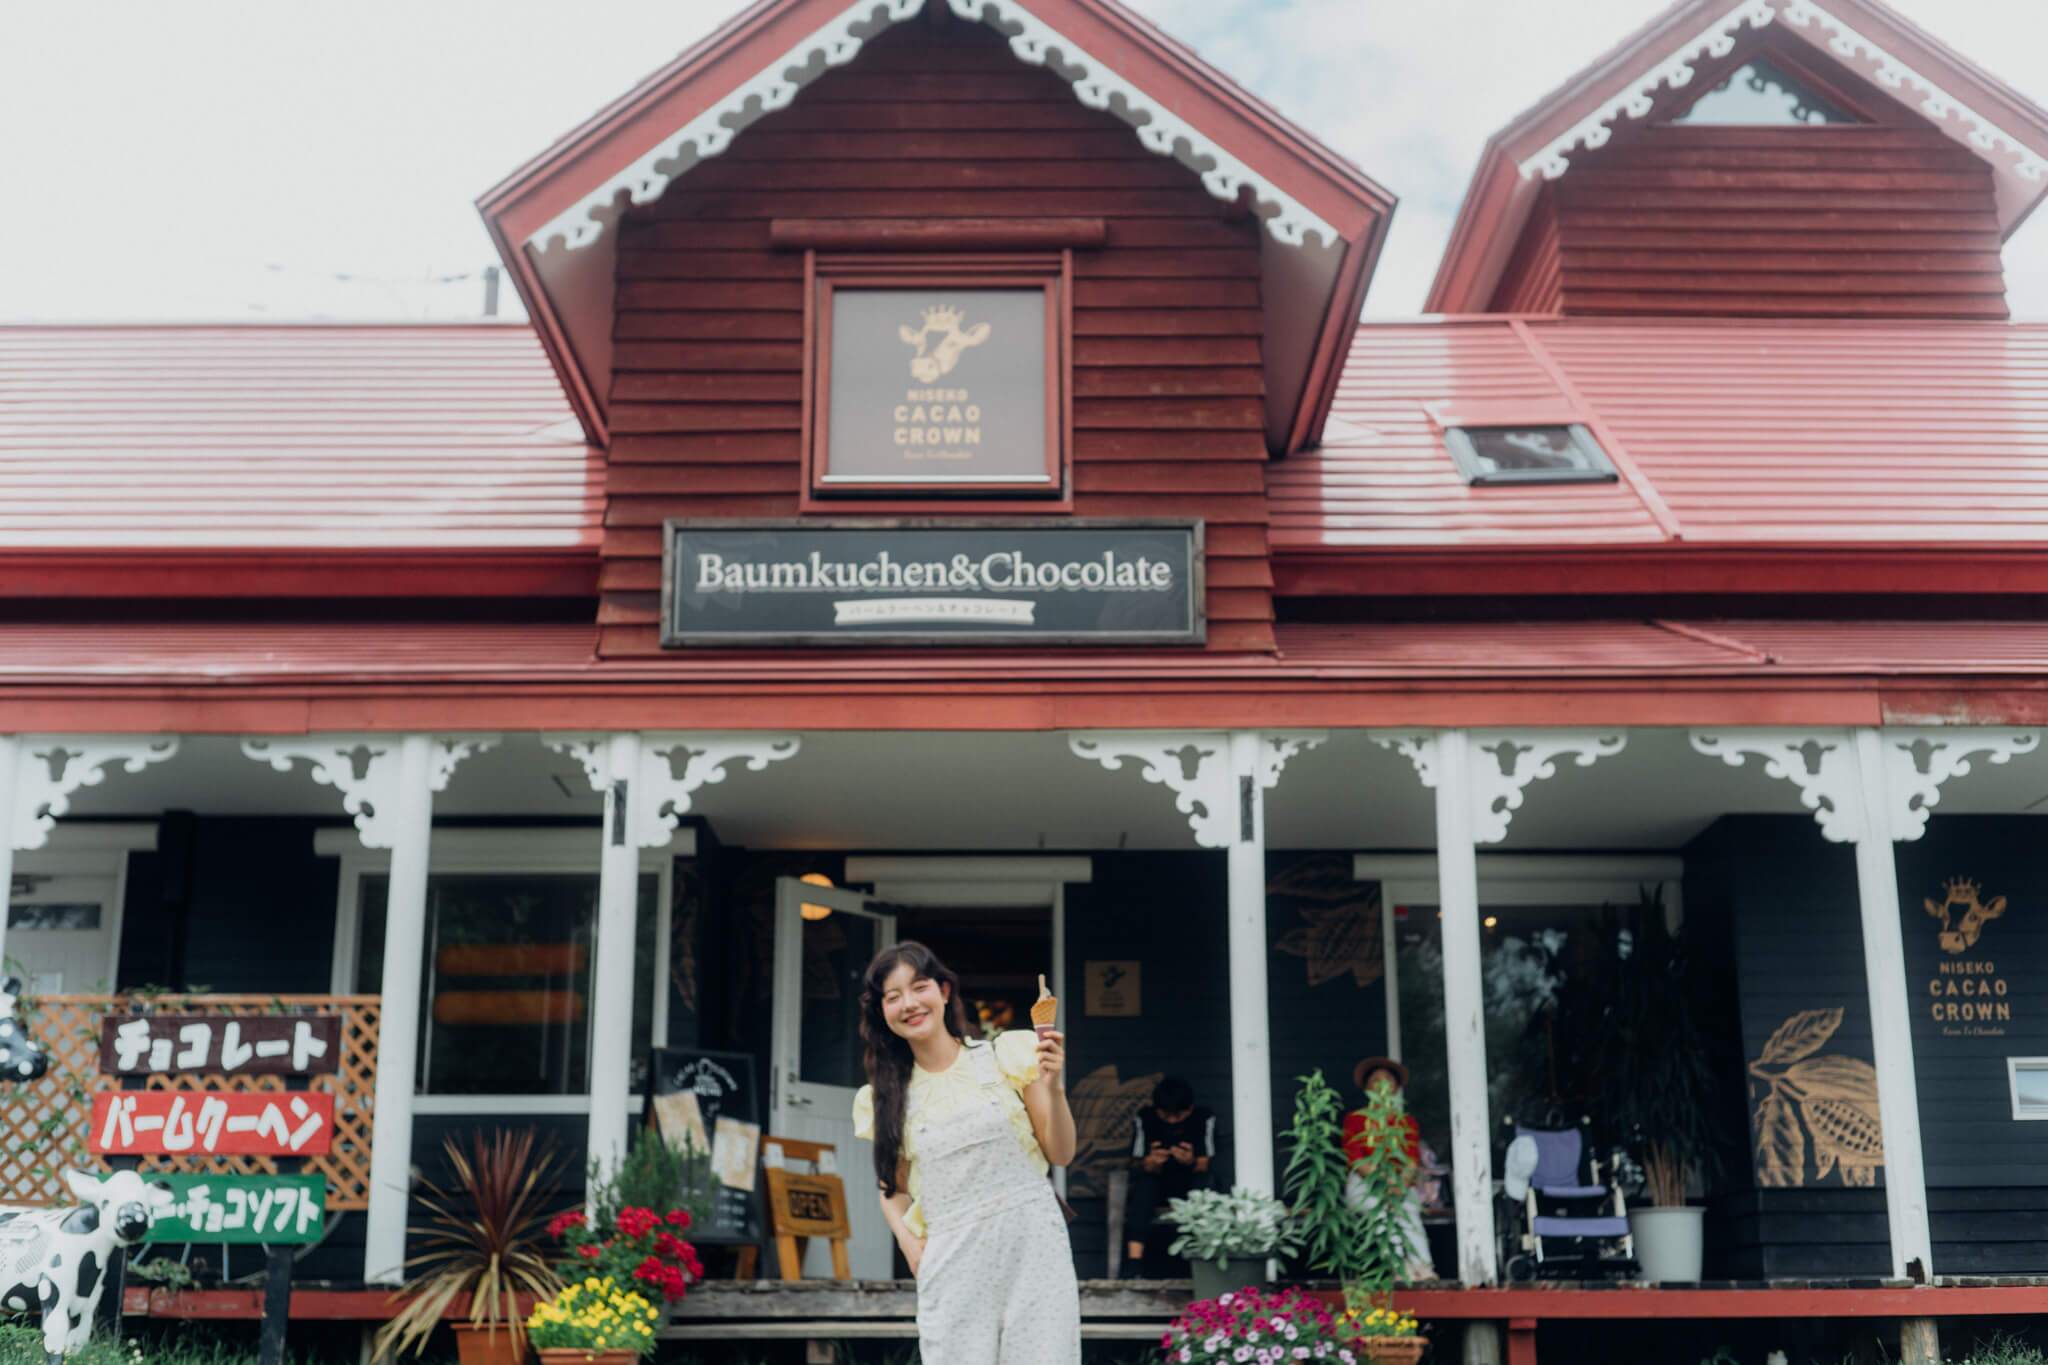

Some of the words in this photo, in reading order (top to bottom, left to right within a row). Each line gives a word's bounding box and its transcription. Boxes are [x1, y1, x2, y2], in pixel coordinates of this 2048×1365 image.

[894, 404, 981, 422] CACAO
[894, 427, 981, 446] CROWN
[696, 550, 1172, 592] Baumkuchen&Chocolate
[1940, 962, 1994, 974] NISEKO
[1930, 979, 2007, 996] CACAO
[1931, 1002, 2011, 1021] CROWN
[114, 1017, 328, 1071] チョコレート
[100, 1095, 324, 1153] バームクーヘン
